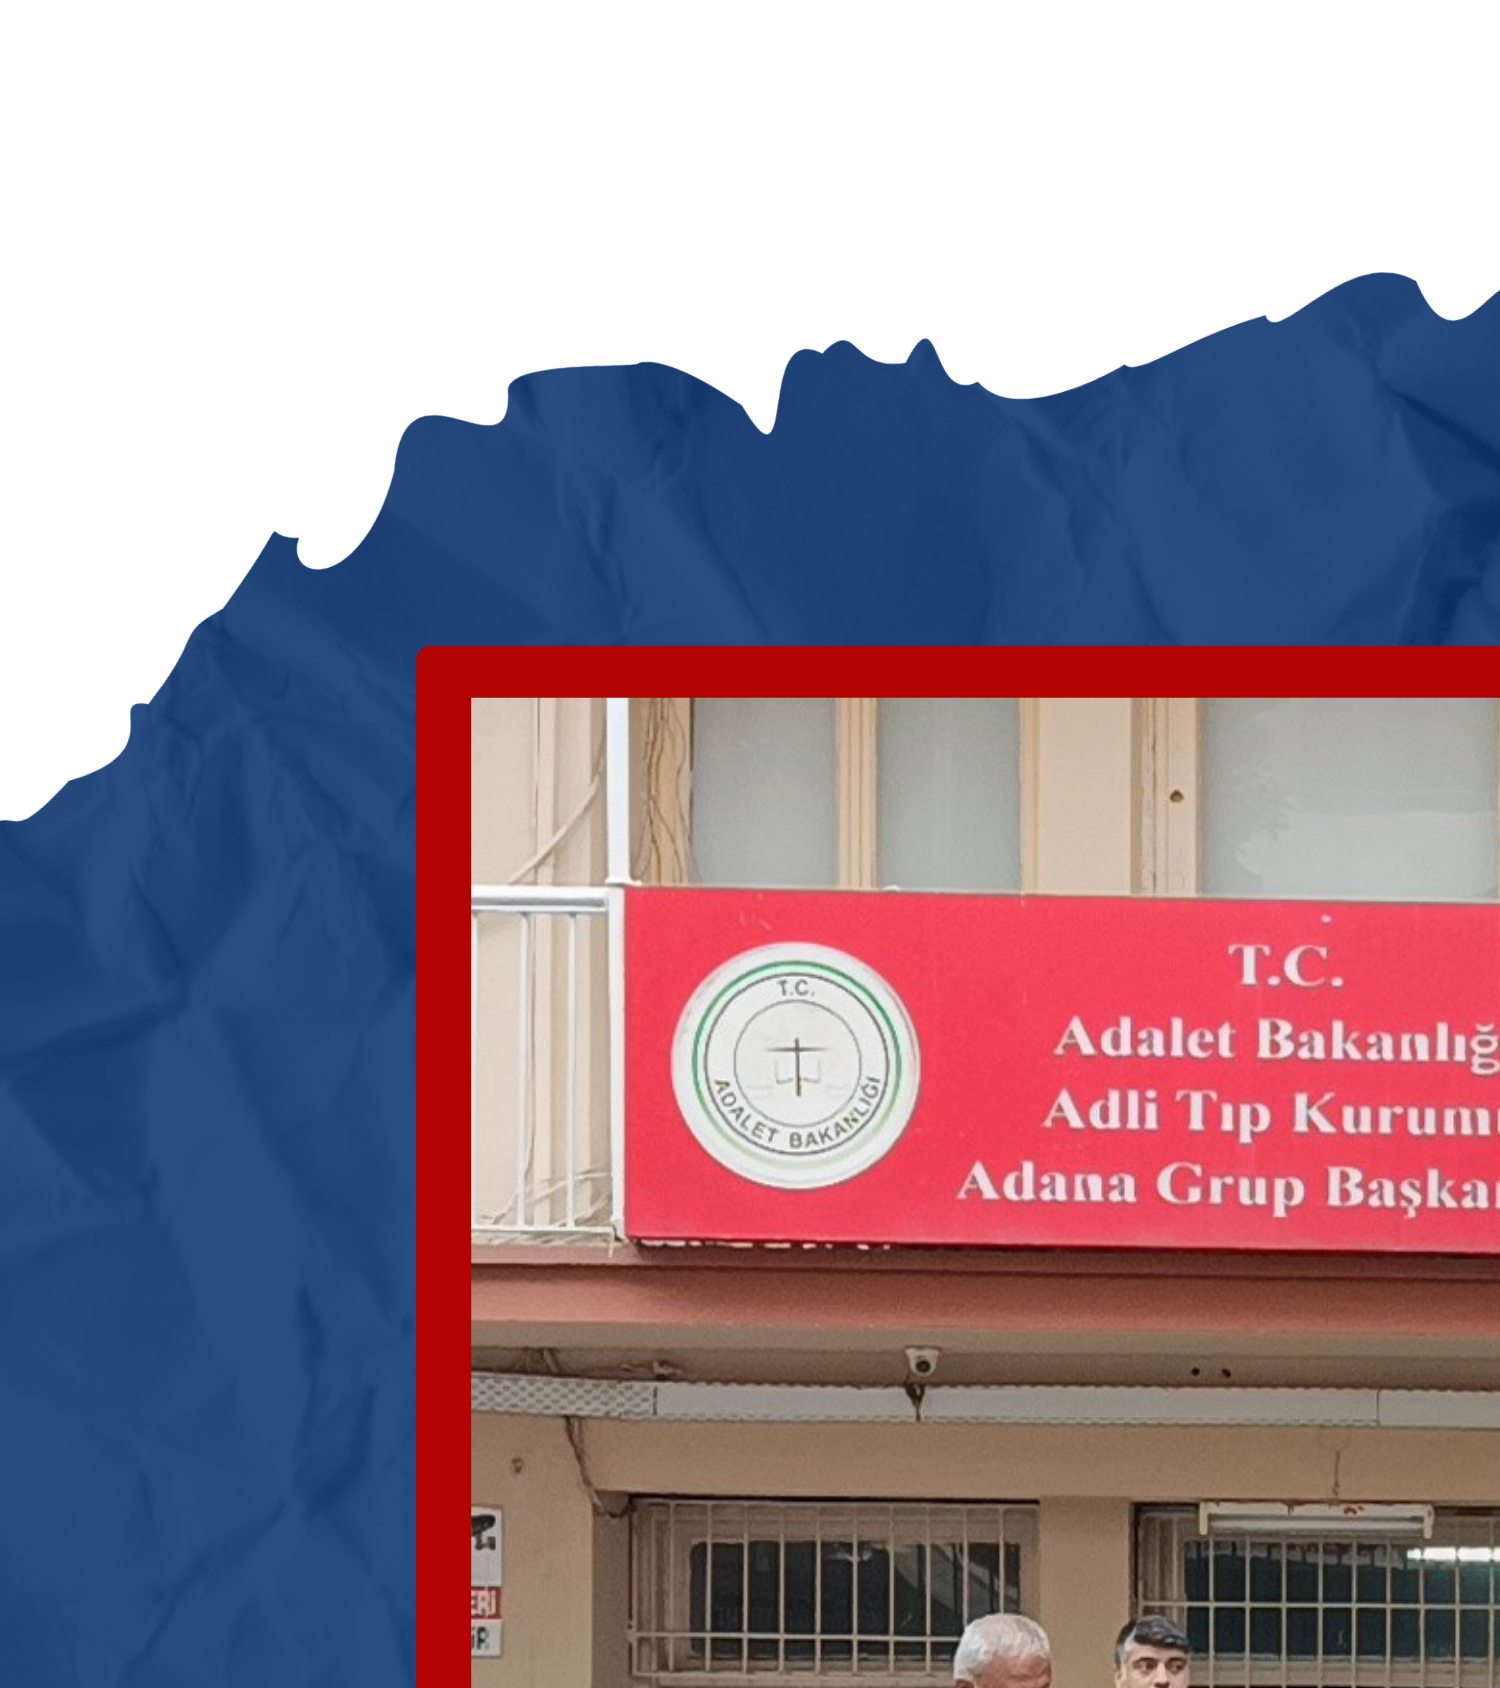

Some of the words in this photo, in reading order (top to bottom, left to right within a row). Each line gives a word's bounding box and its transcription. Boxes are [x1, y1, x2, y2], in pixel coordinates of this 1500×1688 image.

[777, 979, 816, 996] T.C.
[1228, 944, 1344, 987] T.C.
[1053, 1015, 1236, 1059] Adalet
[714, 1079, 780, 1143] ADALET
[789, 1077, 882, 1149] BAKANLIĞI
[1041, 1089, 1159, 1131] Adli
[1175, 1089, 1271, 1143] Tıp
[956, 1160, 1136, 1204] Adana
[1156, 1162, 1304, 1218] Grup
